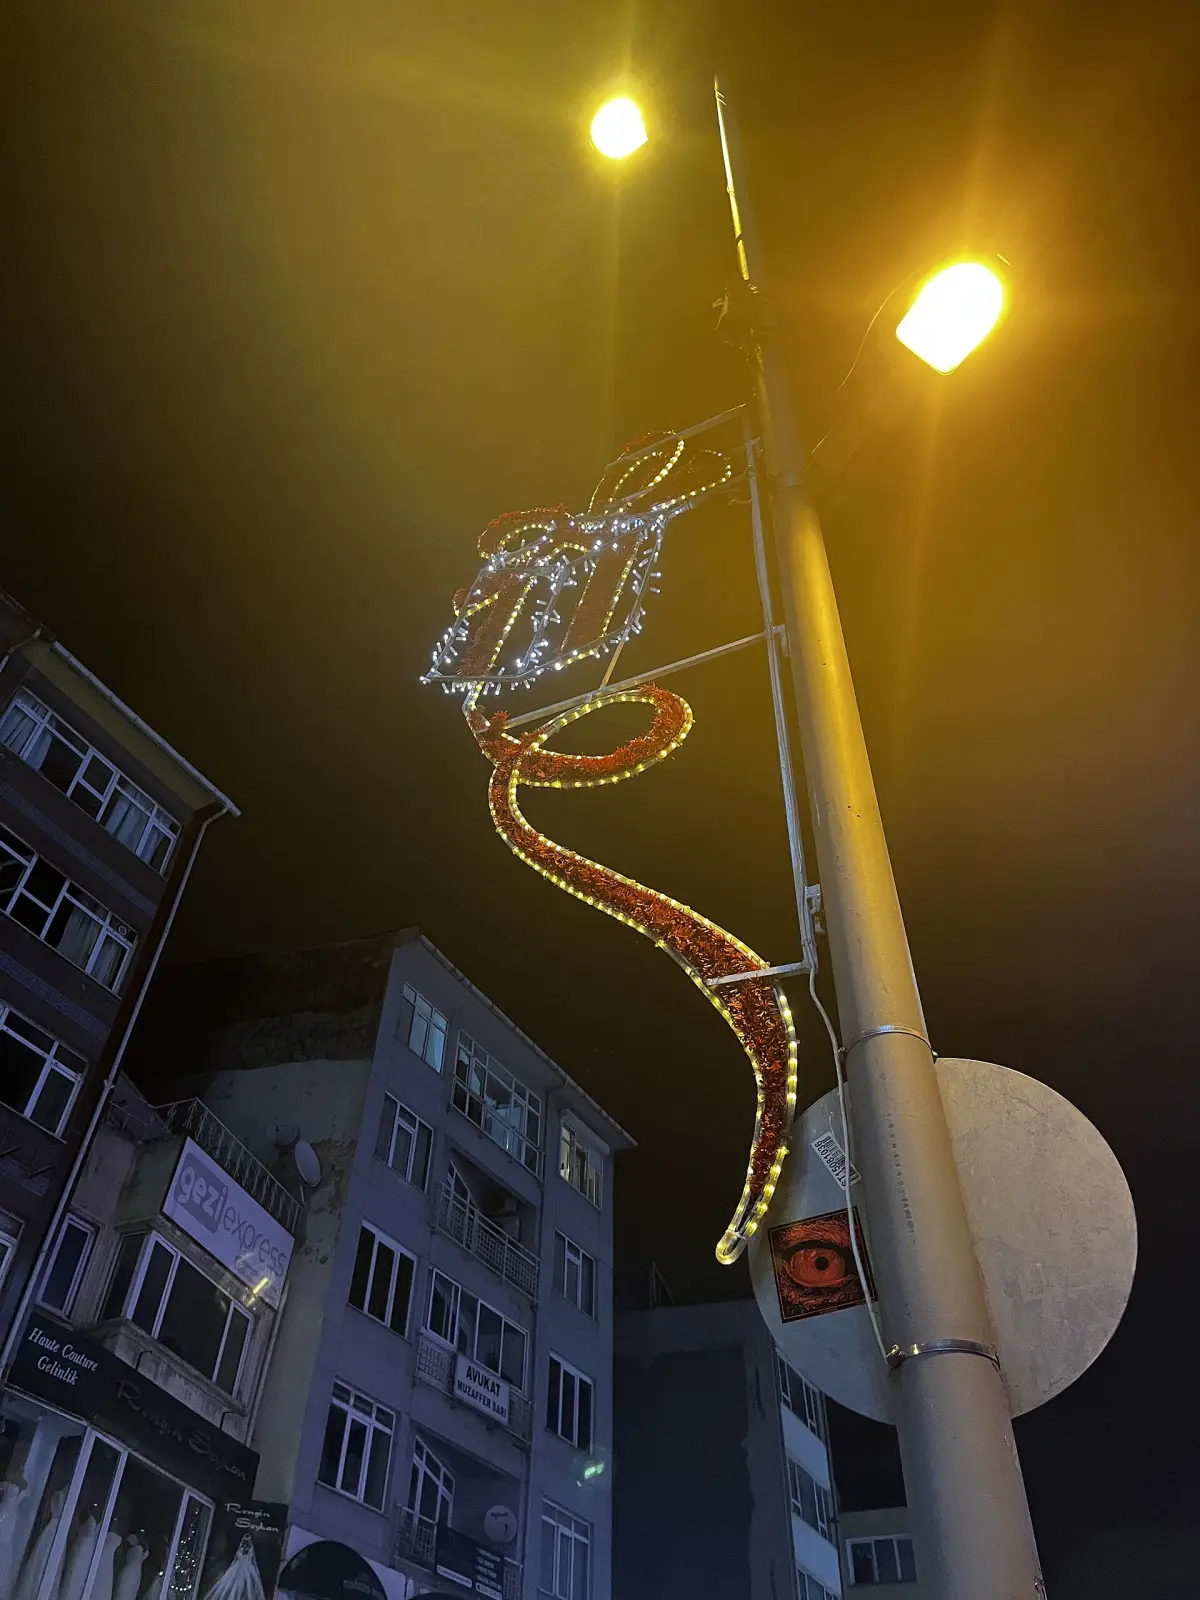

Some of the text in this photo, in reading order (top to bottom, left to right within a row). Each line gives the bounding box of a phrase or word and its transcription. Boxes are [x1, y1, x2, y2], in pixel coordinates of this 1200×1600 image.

[28, 1327, 99, 1372] Haute Couture
[37, 1355, 79, 1386] Gelinlik
[466, 1365, 501, 1397] AVUKAT
[458, 1379, 491, 1408] MUZAFFER
